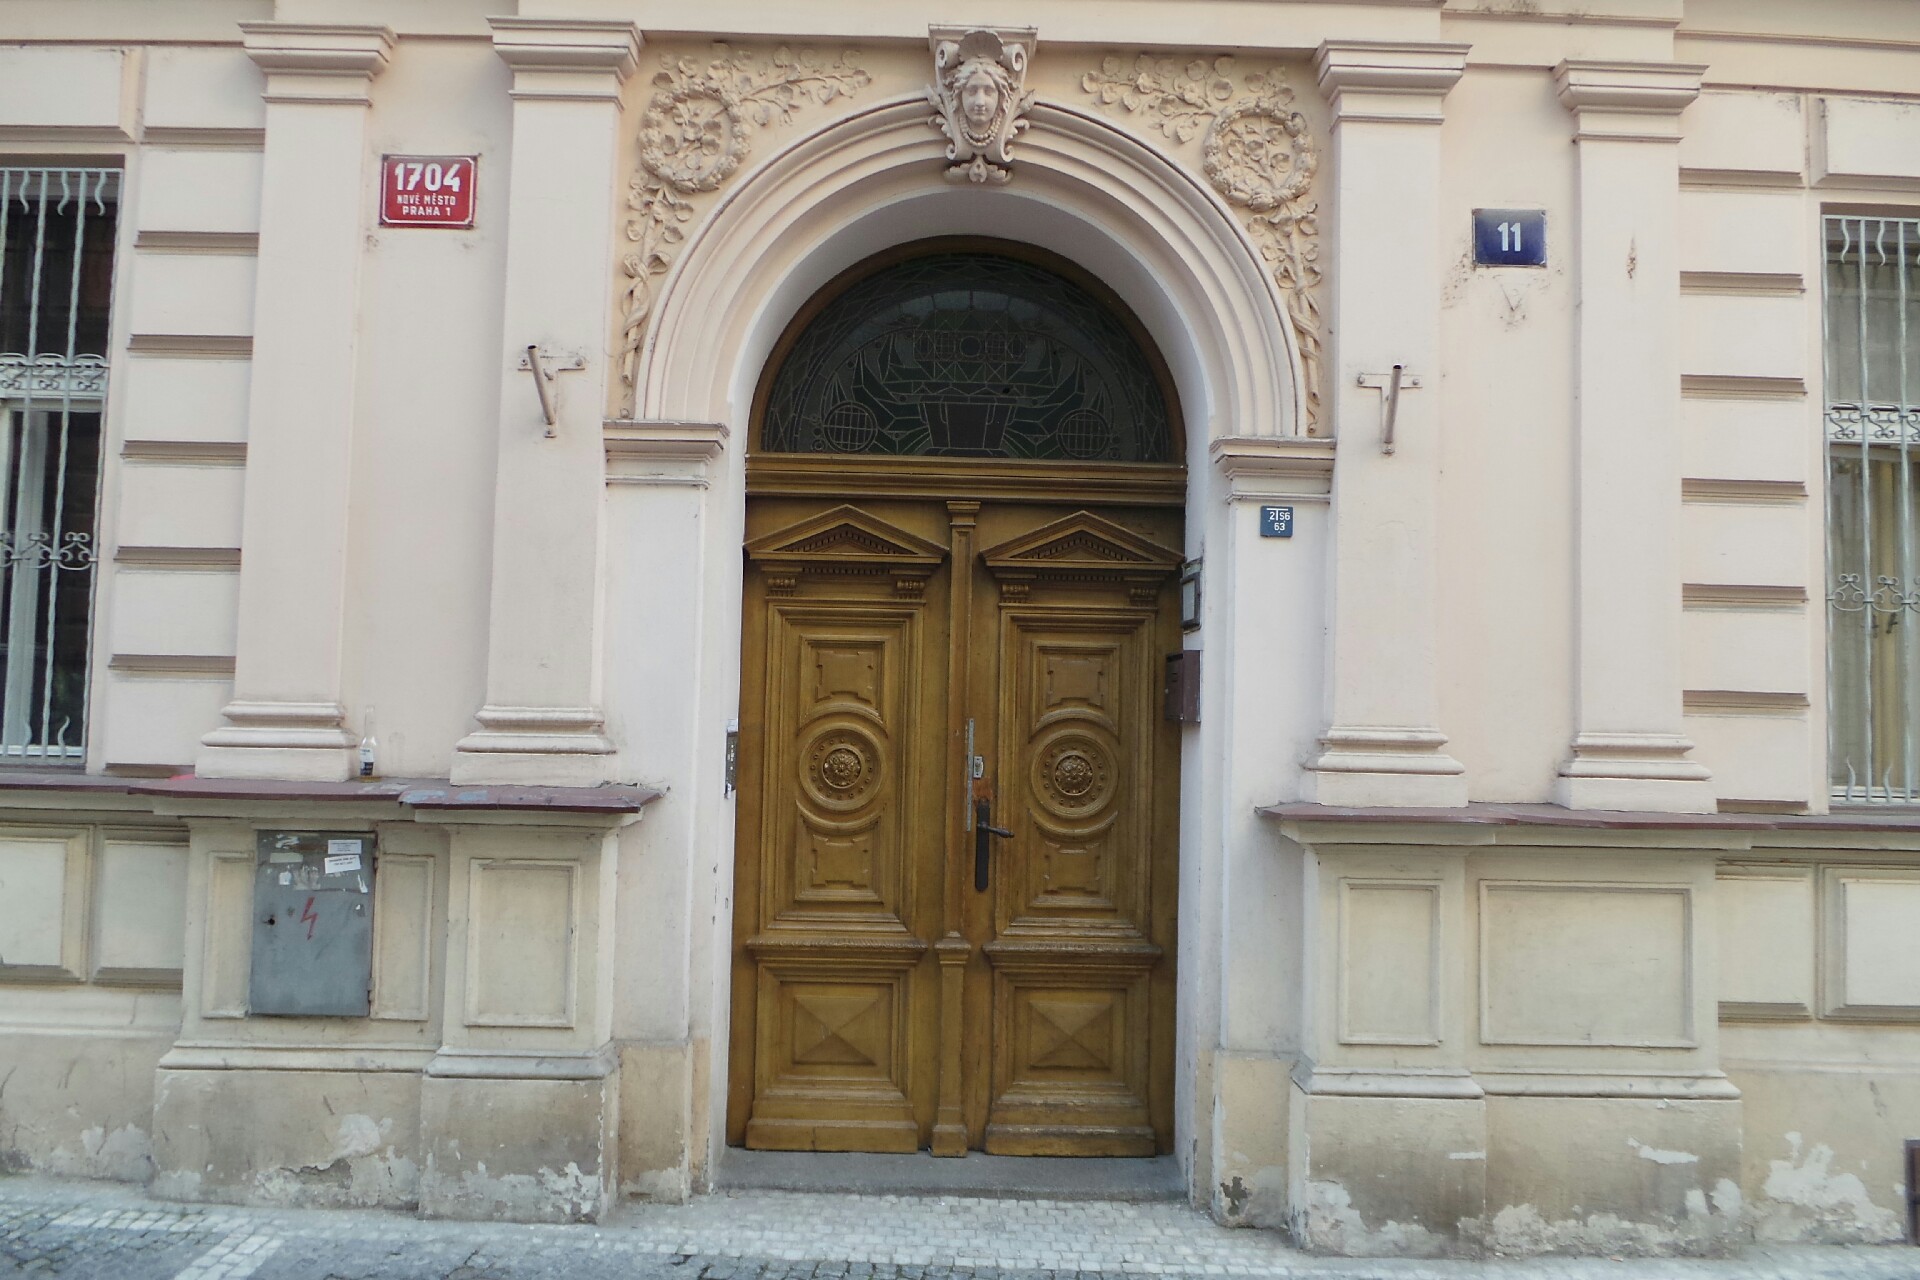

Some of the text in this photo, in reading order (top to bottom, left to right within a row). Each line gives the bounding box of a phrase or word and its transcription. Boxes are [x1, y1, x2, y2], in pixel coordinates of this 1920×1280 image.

[395, 163, 460, 192] 1704
[397, 193, 456, 206] NOVÉ MĚSTO
[402, 206, 451, 216] PRAHA 1
[1497, 222, 1521, 251] 11
[1274, 522, 1286, 531] 63
